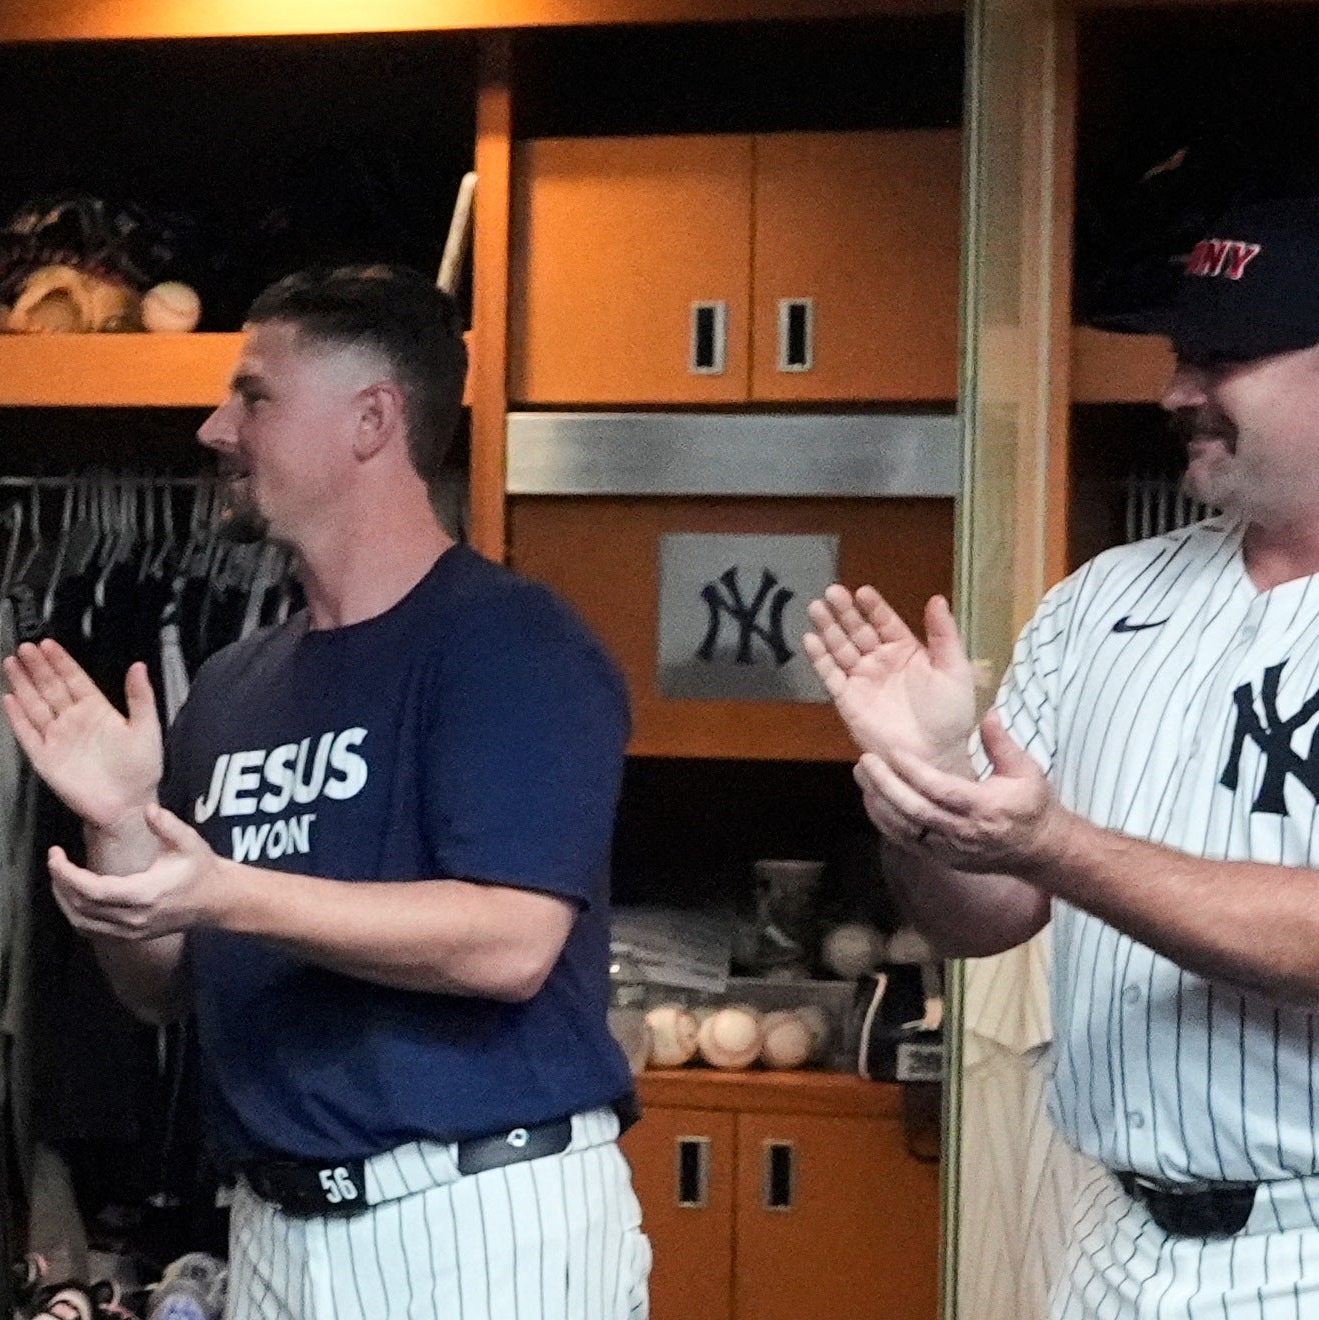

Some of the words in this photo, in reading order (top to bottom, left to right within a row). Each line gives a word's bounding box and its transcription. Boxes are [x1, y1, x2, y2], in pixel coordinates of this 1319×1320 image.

[695, 565, 797, 667] NY
[194, 726, 369, 824] JESUS
[1219, 657, 1319, 817] NY
[318, 1166, 359, 1204] 56
